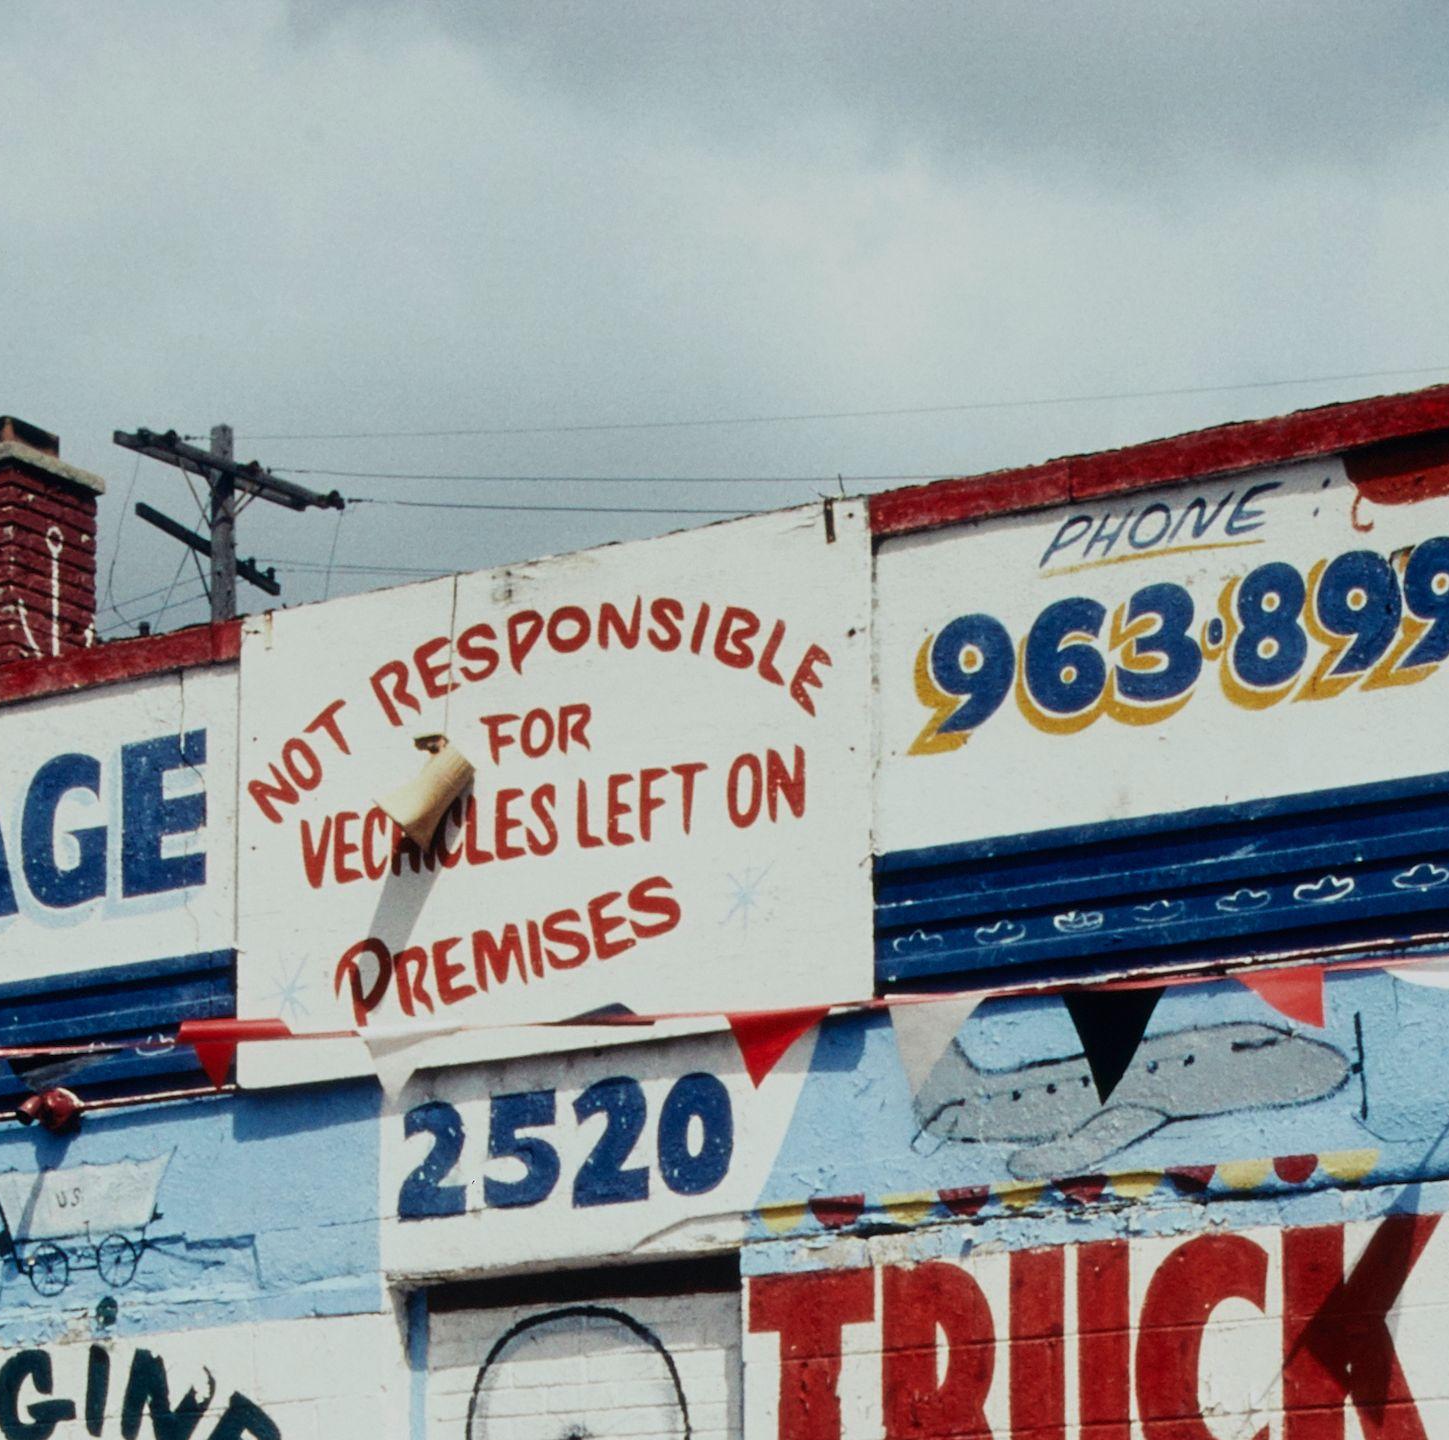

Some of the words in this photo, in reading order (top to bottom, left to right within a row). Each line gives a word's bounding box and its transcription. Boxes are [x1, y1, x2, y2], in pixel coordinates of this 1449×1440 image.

[248, 700, 351, 823] NOT
[369, 596, 833, 725] RESPONSIBLE
[479, 703, 591, 765] FOR
[577, 762, 709, 849] LEFT
[726, 744, 806, 829] ON
[334, 876, 681, 1027] PREMISES
[55, 1186, 82, 1209] US
[398, 1071, 734, 1223] 2520
